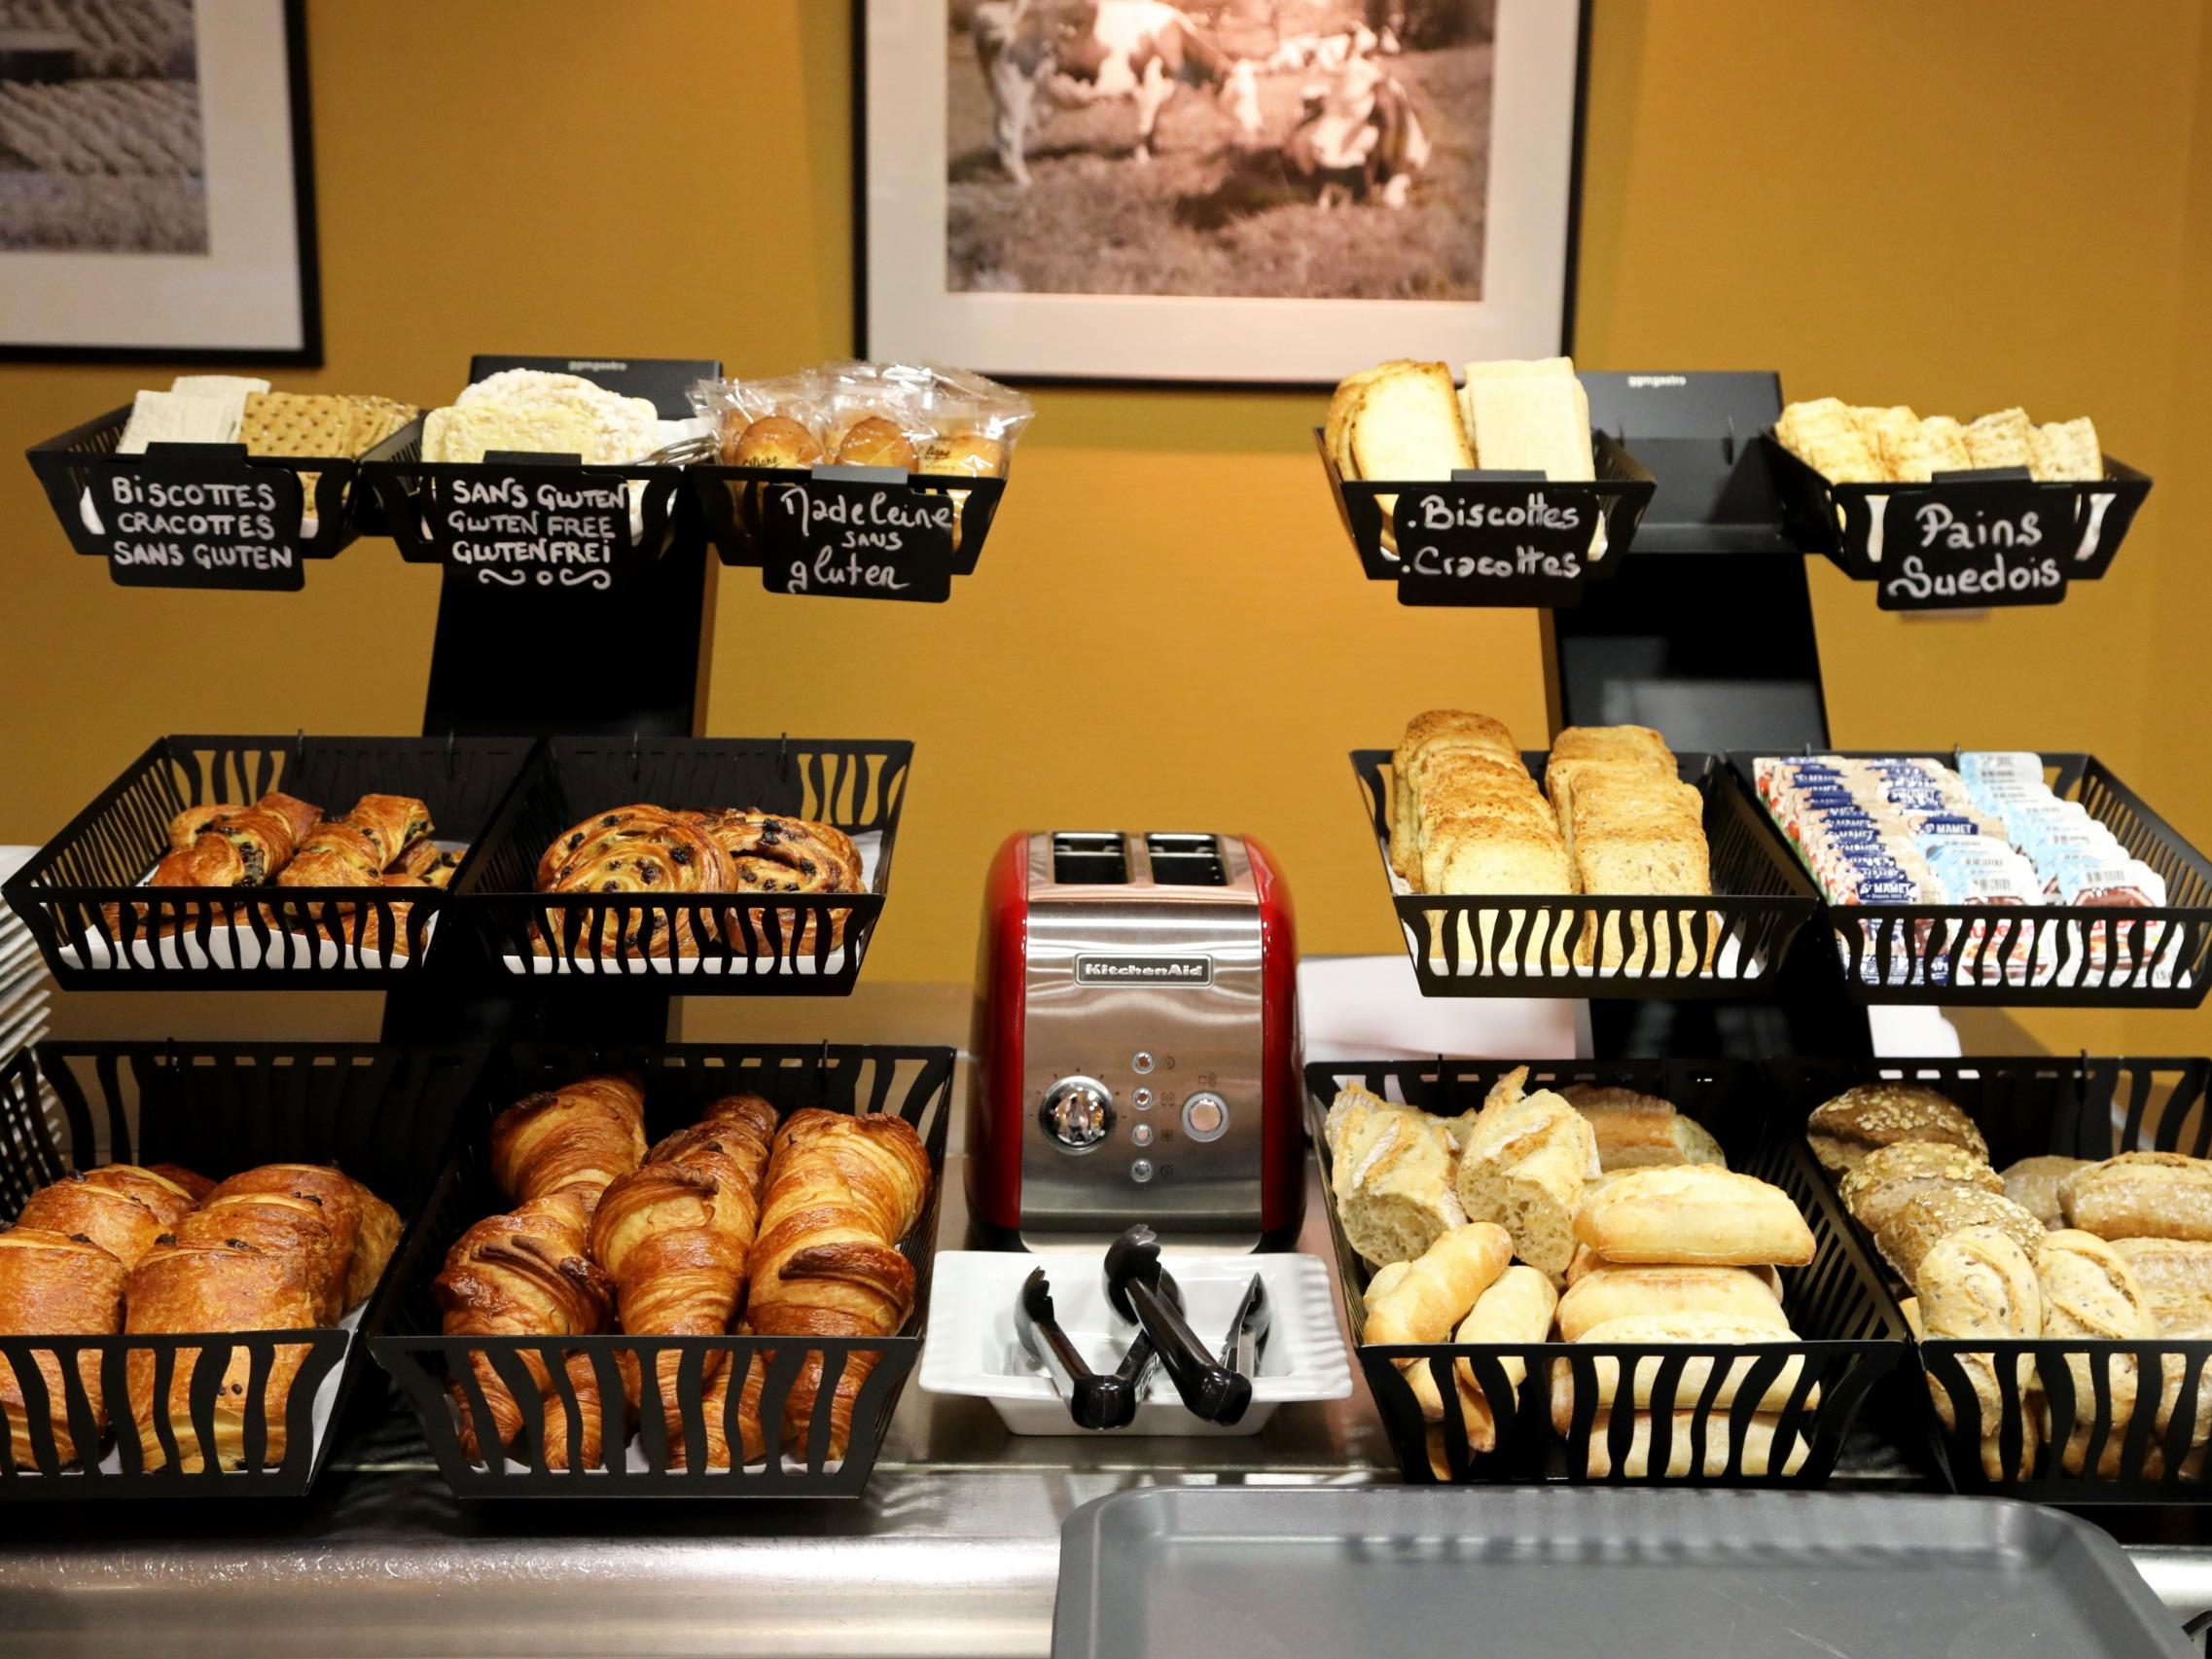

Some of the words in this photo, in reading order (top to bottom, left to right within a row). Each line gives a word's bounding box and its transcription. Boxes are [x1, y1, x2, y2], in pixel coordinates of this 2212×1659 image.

[452, 475, 529, 509] SANS
[537, 483, 628, 511] GLUTEN
[118, 512, 274, 540] CRACOTTES
[447, 509, 540, 535] GLUTEN
[548, 516, 616, 538] FREE
[1914, 502, 2042, 548] Pains
[114, 540, 185, 566] SANS
[193, 542, 292, 570] GLUTEN
[787, 545, 910, 594] gluten
[1887, 553, 2060, 598] Suedois
[1937, 823, 1972, 834] MAMET
[1873, 883, 1909, 893] MAMET
[1086, 964, 1202, 976] KitchenAid
